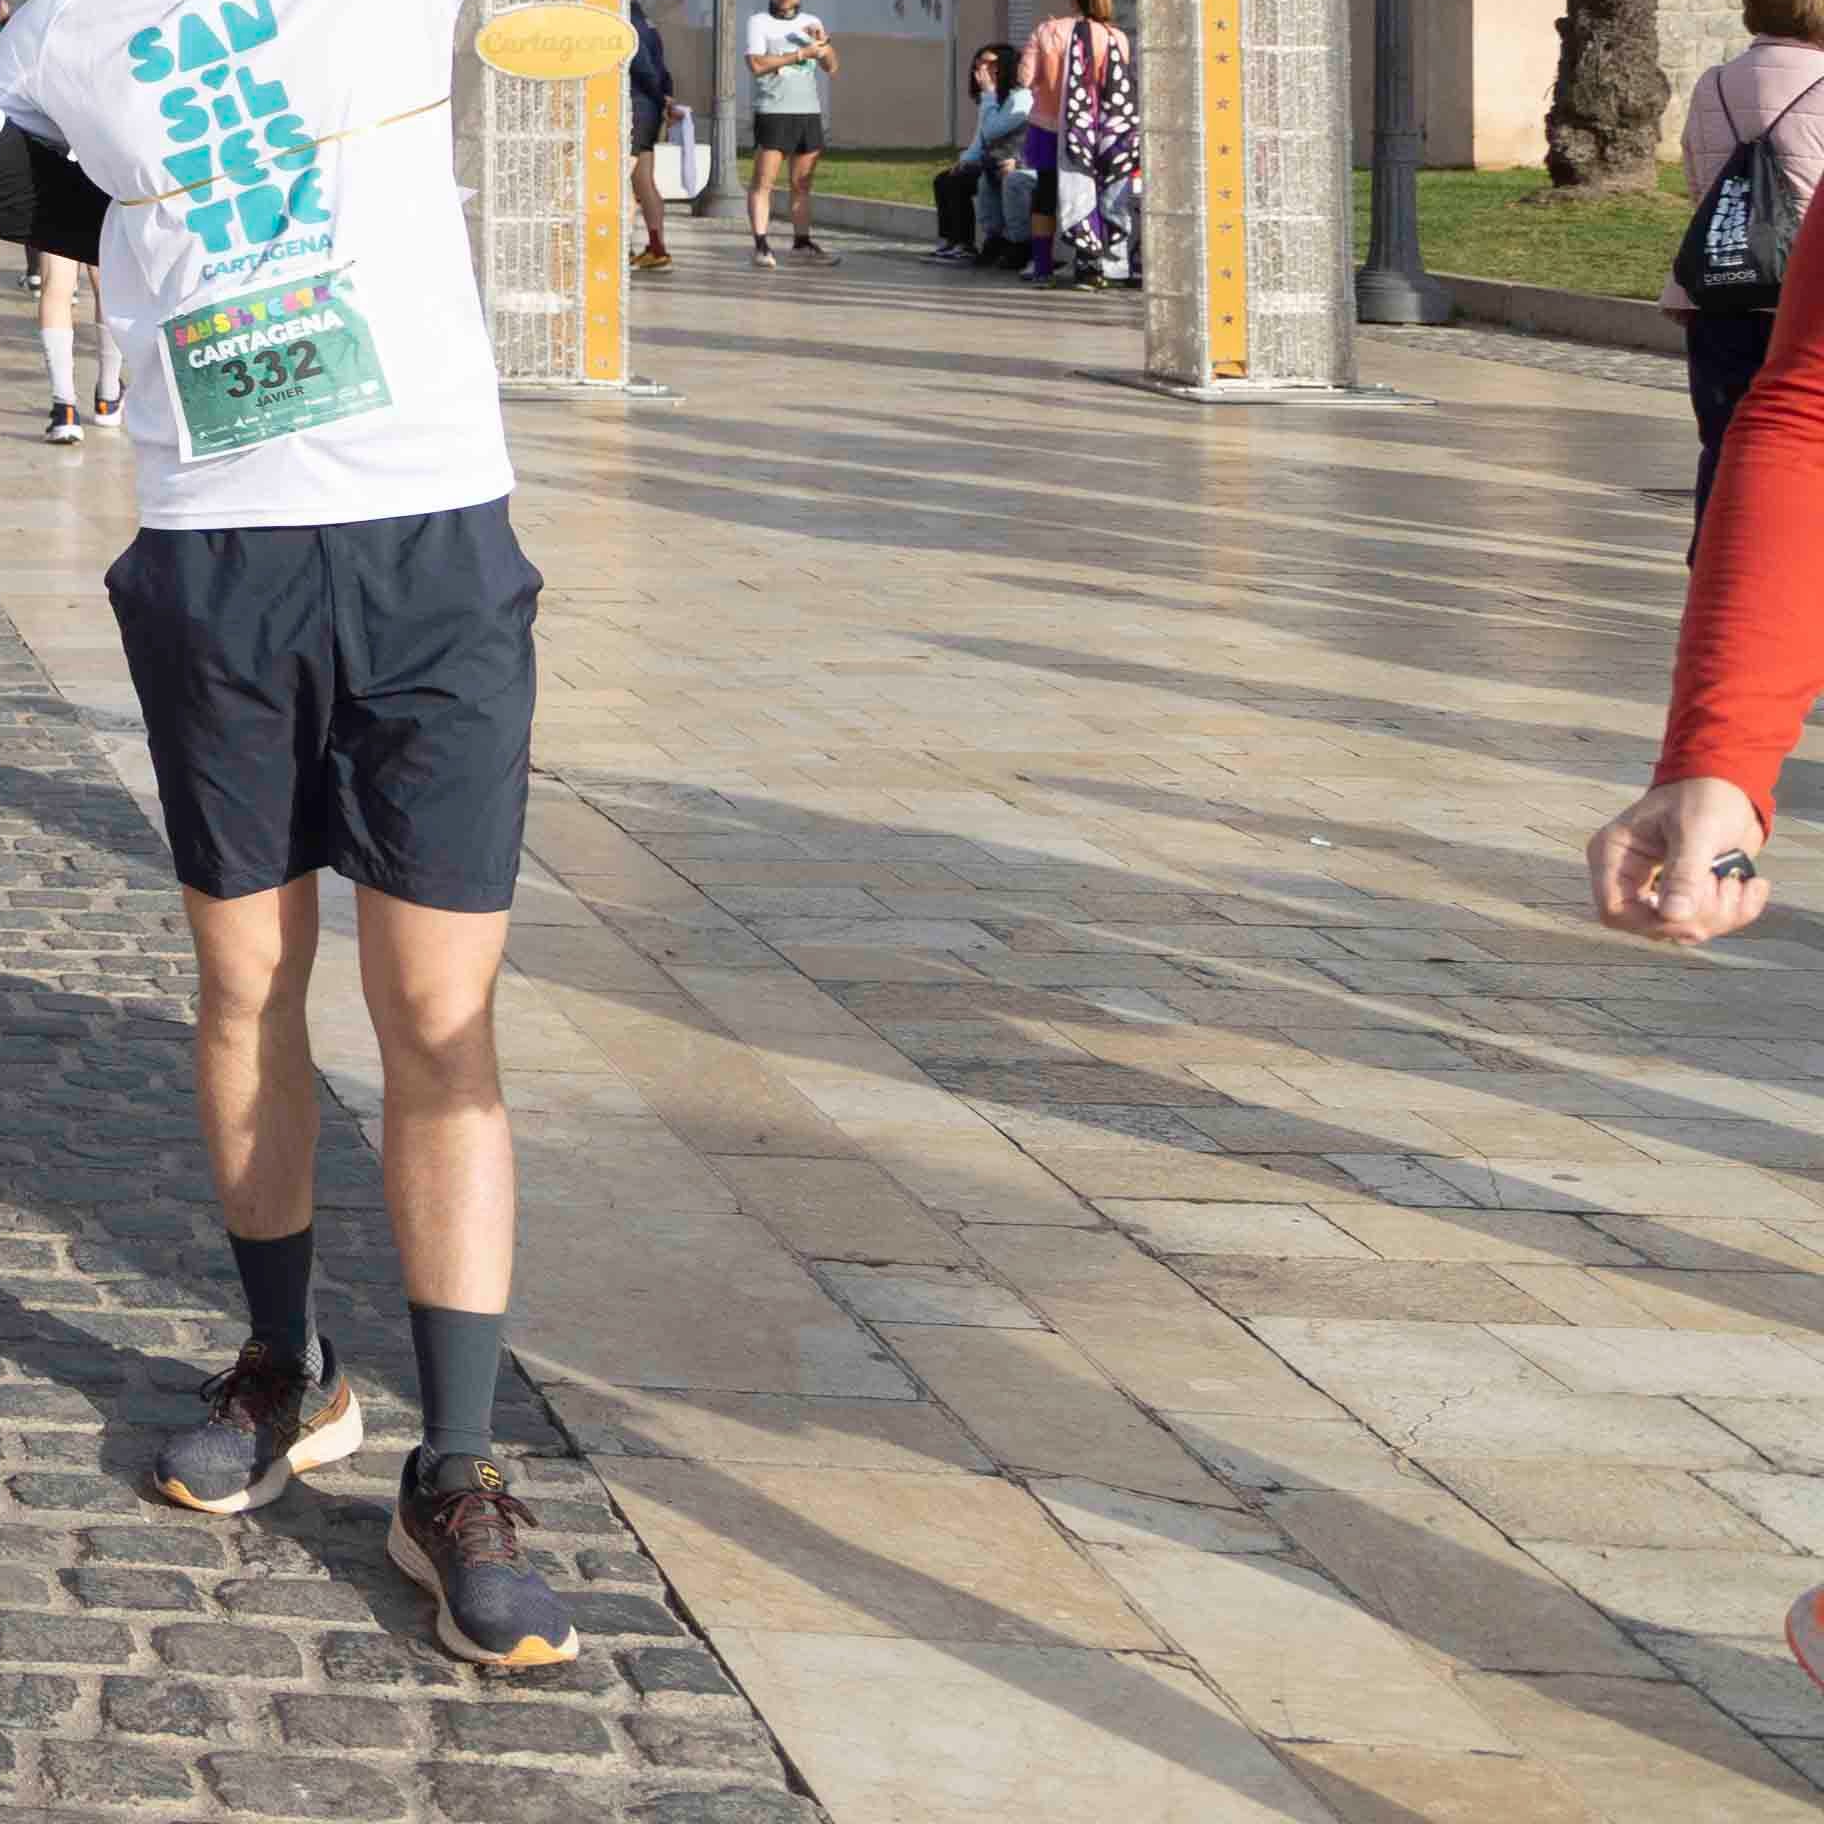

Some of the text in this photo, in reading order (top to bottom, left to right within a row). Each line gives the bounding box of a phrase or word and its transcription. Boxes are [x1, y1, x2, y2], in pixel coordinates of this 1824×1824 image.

[162, 114, 319, 204] VES
[186, 168, 331, 254] TRE
[201, 232, 334, 282] CARTAGENA
[188, 309, 344, 370] CARTAGENA
[221, 340, 322, 399] 332
[256, 386, 305, 408] JAVIER
